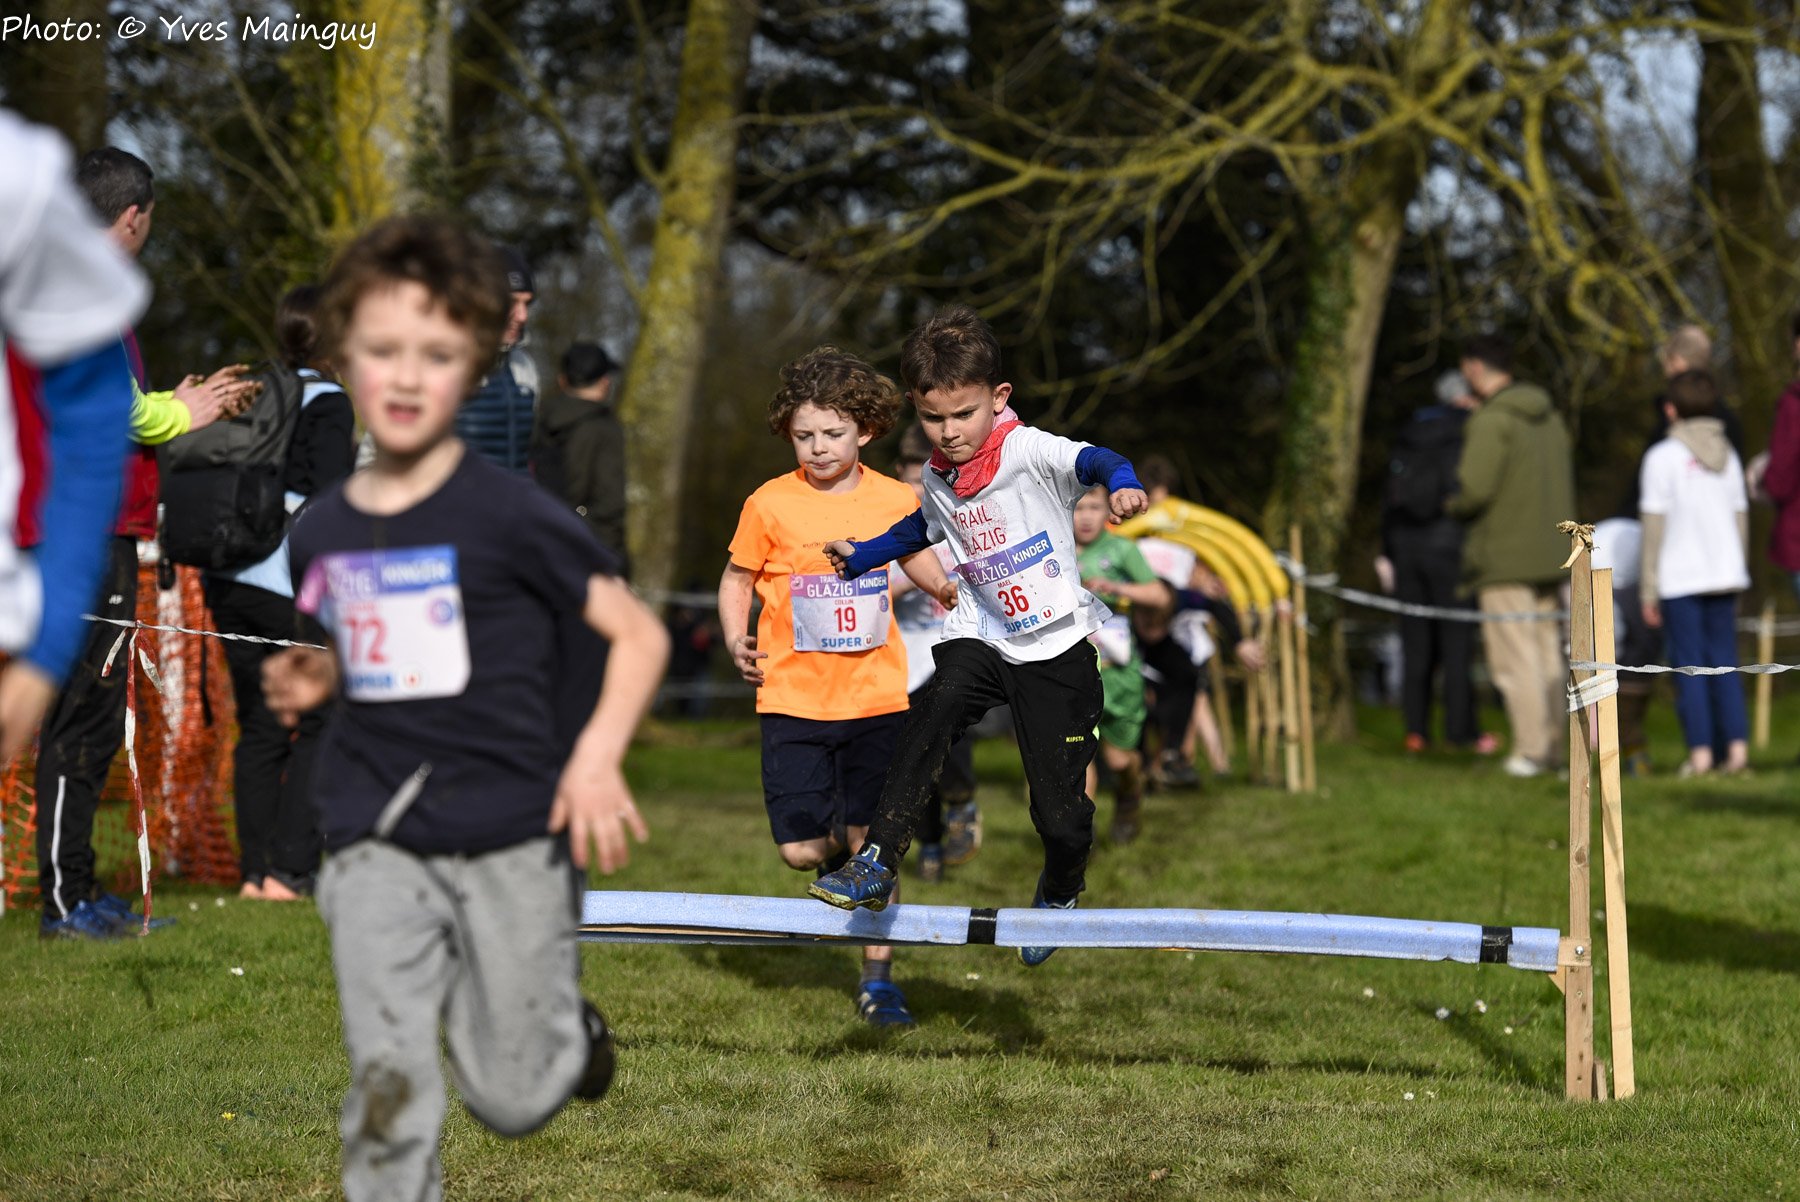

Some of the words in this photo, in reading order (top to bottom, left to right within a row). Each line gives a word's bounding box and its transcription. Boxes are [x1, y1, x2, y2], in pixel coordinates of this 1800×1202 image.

[953, 505, 993, 531] TRAIL
[962, 527, 1007, 557] GLAZIG
[1012, 538, 1050, 564] KINDER
[969, 562, 1010, 585] GLAZIG
[974, 559, 990, 570] TRAIL
[807, 583, 854, 597] GLAZIG
[859, 576, 887, 589] KINDER
[997, 580, 1013, 588] MAEL
[997, 585, 1030, 617] 36
[834, 606, 856, 632] 19
[1003, 614, 1041, 633] SUPER
[821, 637, 862, 647] SUPER
